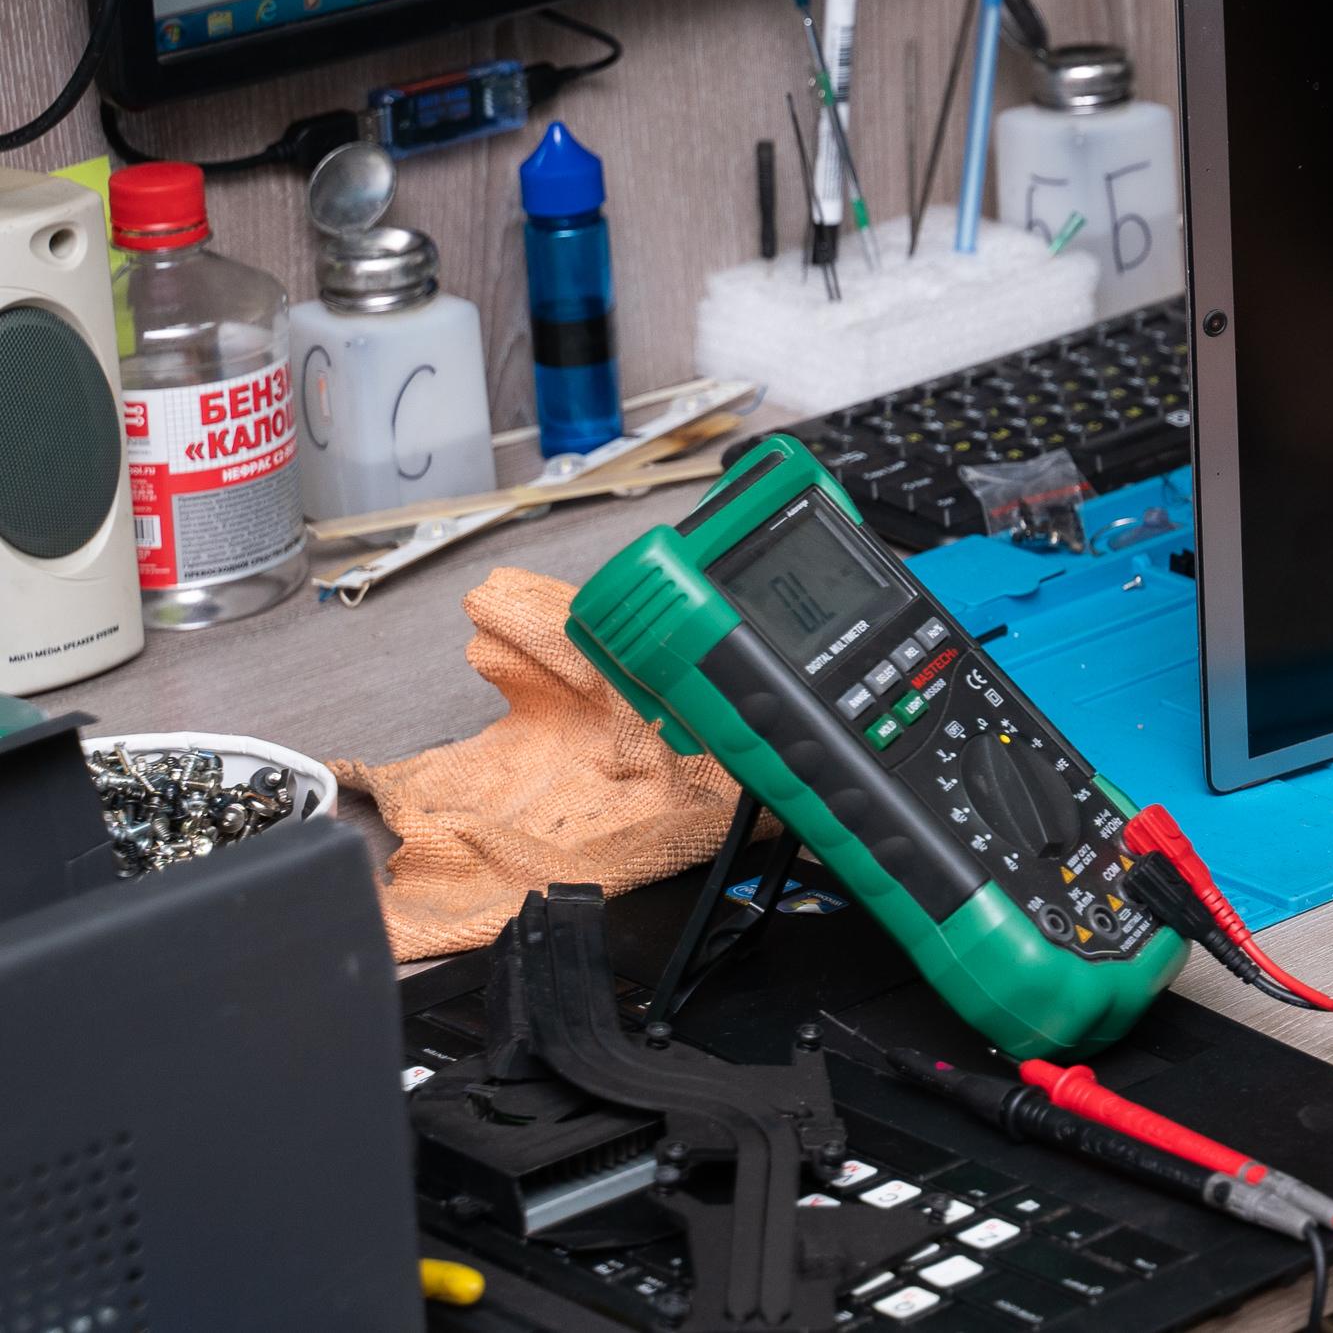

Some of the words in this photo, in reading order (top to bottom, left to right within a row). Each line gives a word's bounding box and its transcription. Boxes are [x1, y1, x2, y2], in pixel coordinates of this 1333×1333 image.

[1105, 160, 1152, 275] Б
[200, 363, 292, 426] БЕНЗ
[8, 652, 34, 664] MULTI
[35, 646, 62, 658] MEDIA
[63, 635, 95, 652] SPEAKER
[96, 624, 120, 640] SYSTEM
[804, 650, 834, 676] DIGITAL
[828, 619, 871, 656] MULTIMETER
[848, 688, 872, 710] RANGE
[876, 664, 898, 685] SELECT
[904, 646, 920, 660] REL
[911, 649, 954, 690] MASTECH
[877, 720, 898, 738] HOLD
[905, 696, 925, 715] LIGHT
[1102, 862, 1122, 882] COM
[1026, 896, 1046, 913] 10A
